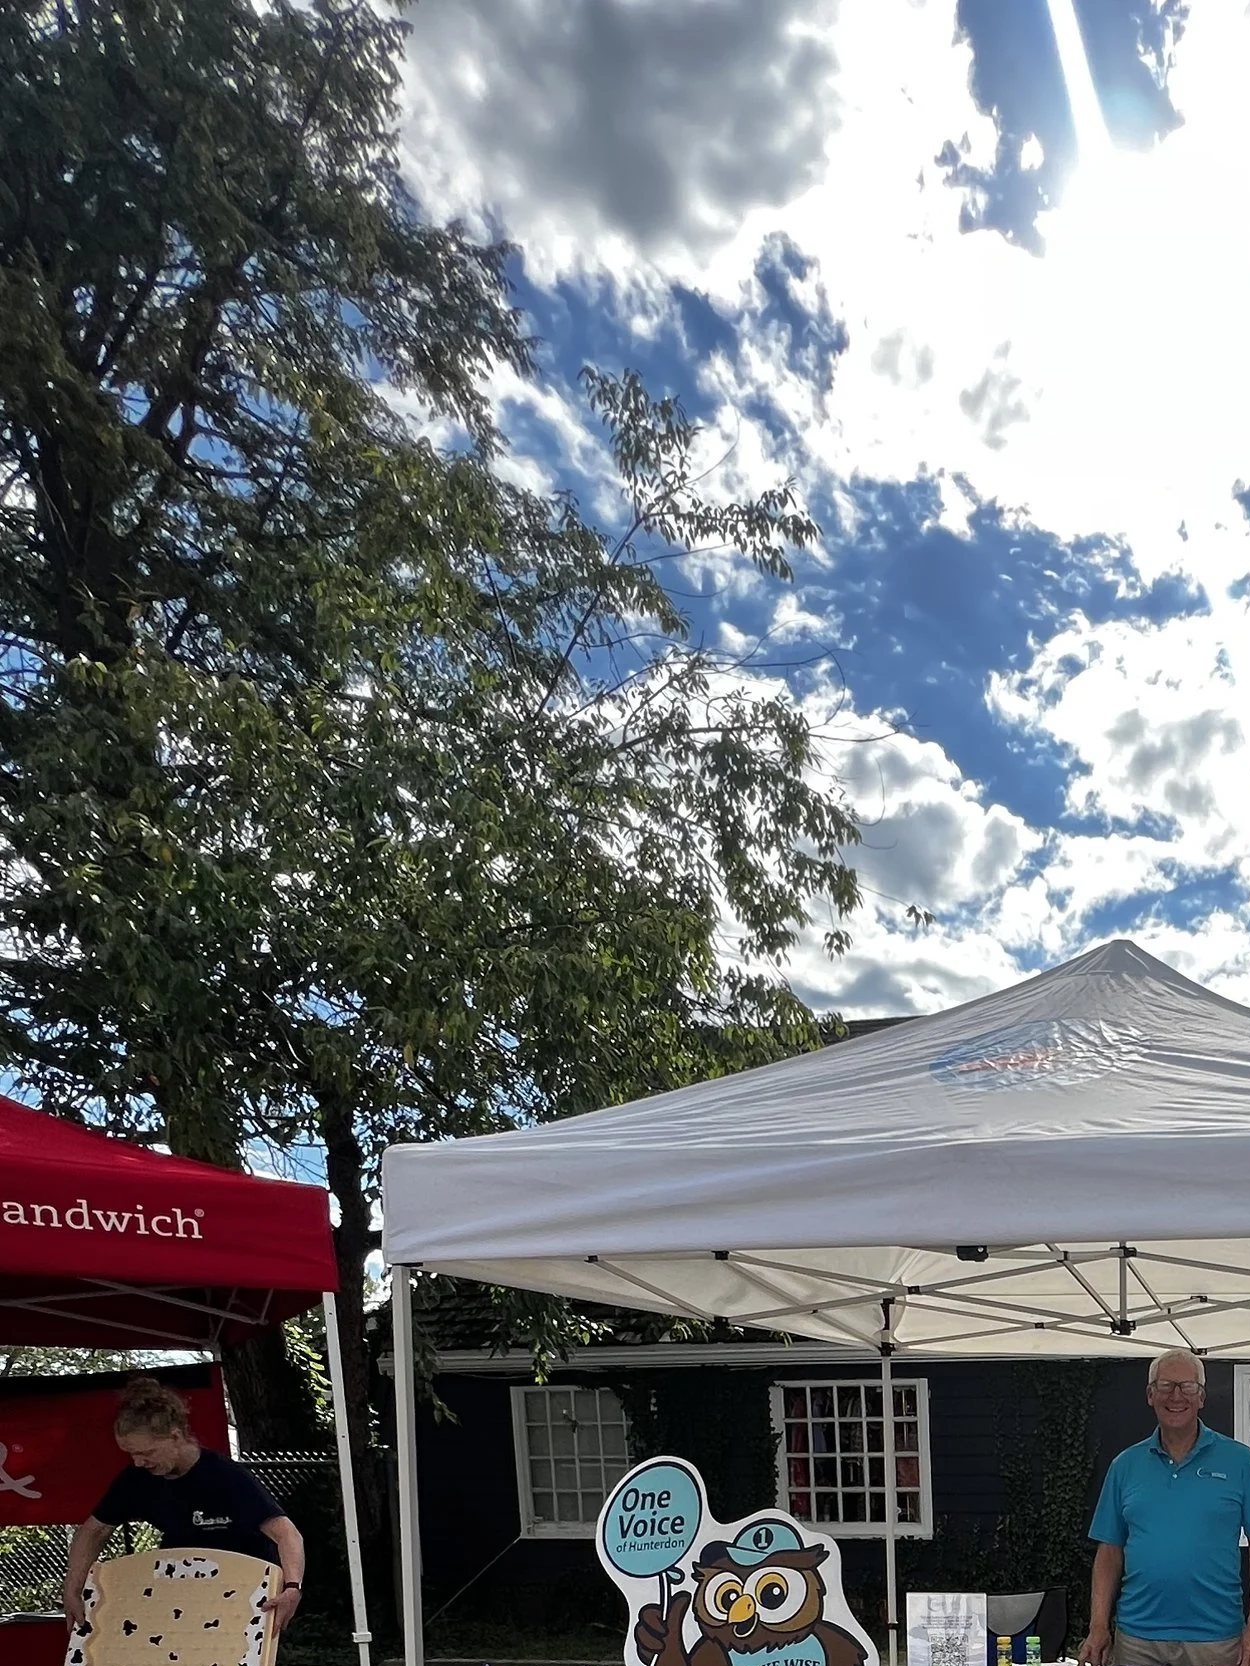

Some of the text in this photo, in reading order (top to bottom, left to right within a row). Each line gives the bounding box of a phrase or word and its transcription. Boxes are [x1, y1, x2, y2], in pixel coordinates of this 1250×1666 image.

[621, 1487, 671, 1512] One
[618, 1511, 685, 1539] Voice
[616, 1537, 685, 1553] of Hunterdon
